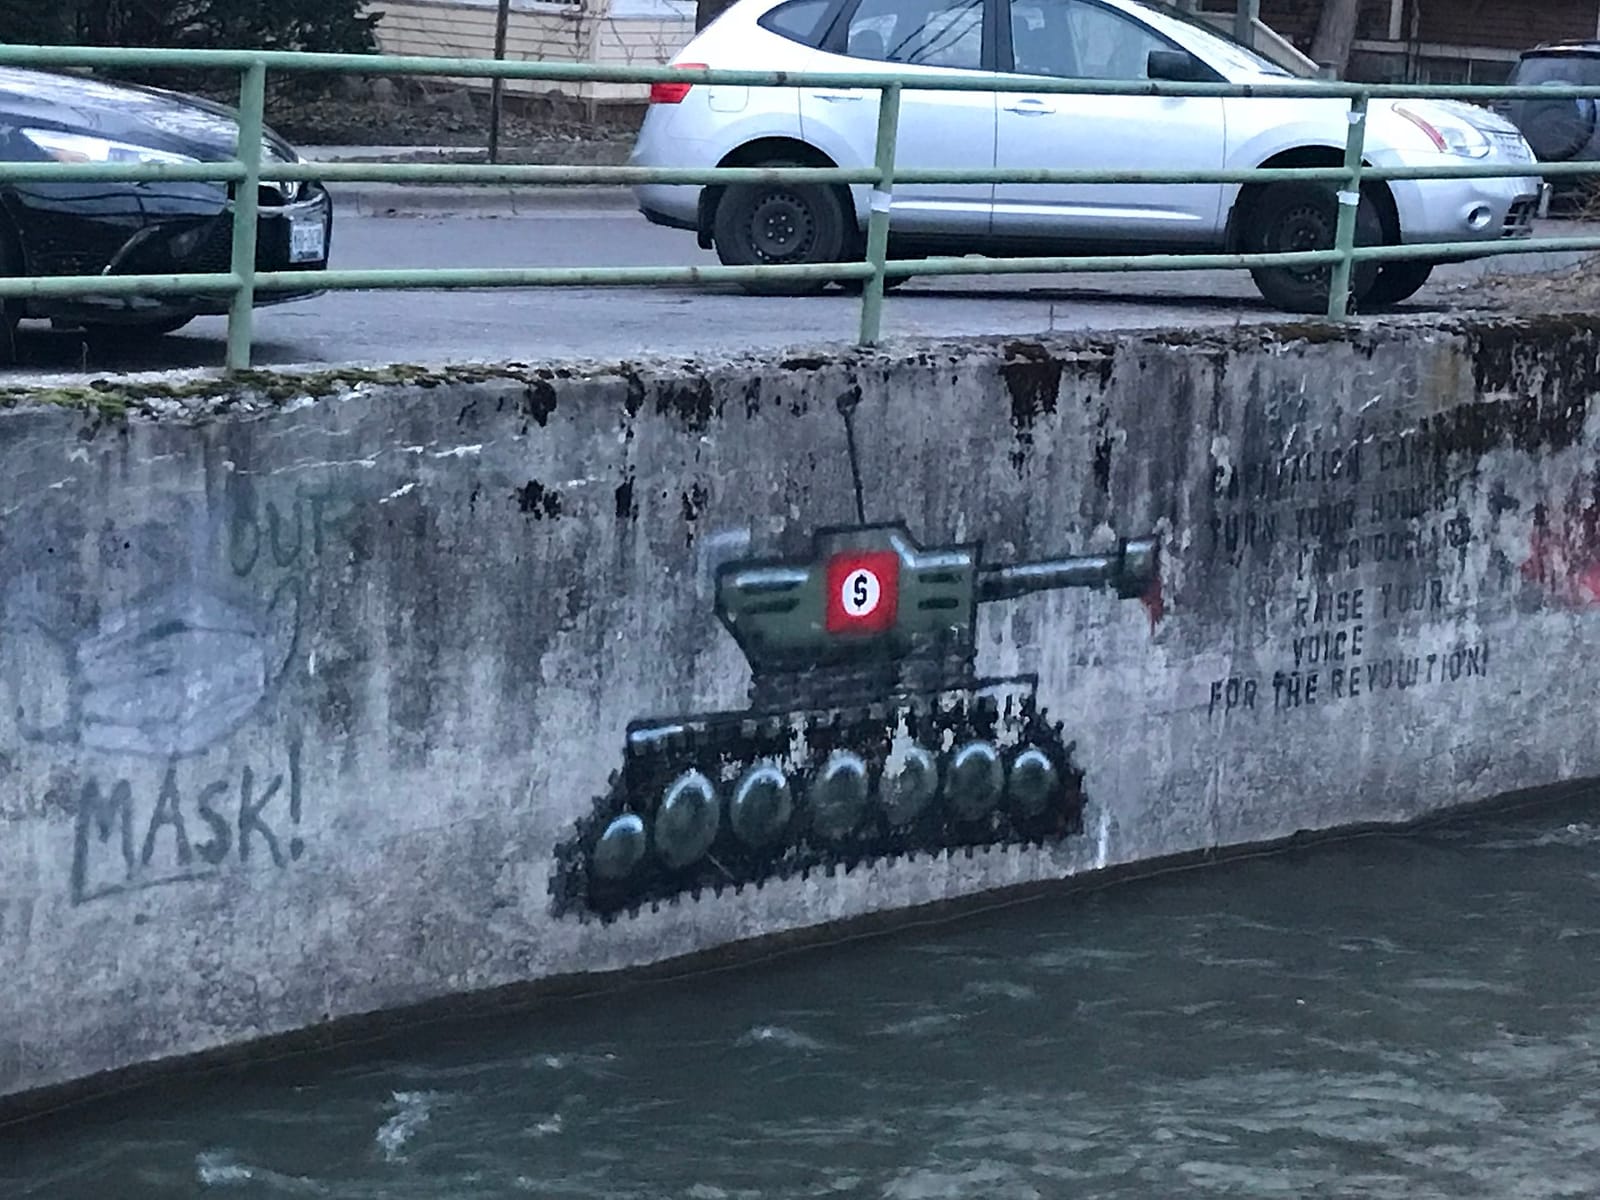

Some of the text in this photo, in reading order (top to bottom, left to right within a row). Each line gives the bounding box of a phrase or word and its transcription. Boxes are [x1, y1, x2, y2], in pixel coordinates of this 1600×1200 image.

[1297, 579, 1443, 627] RAISE YOUR
[1293, 625, 1363, 678] VOICE
[1208, 677, 1257, 718] FOR
[1272, 670, 1318, 710] THE
[72, 738, 304, 905] MASK!
